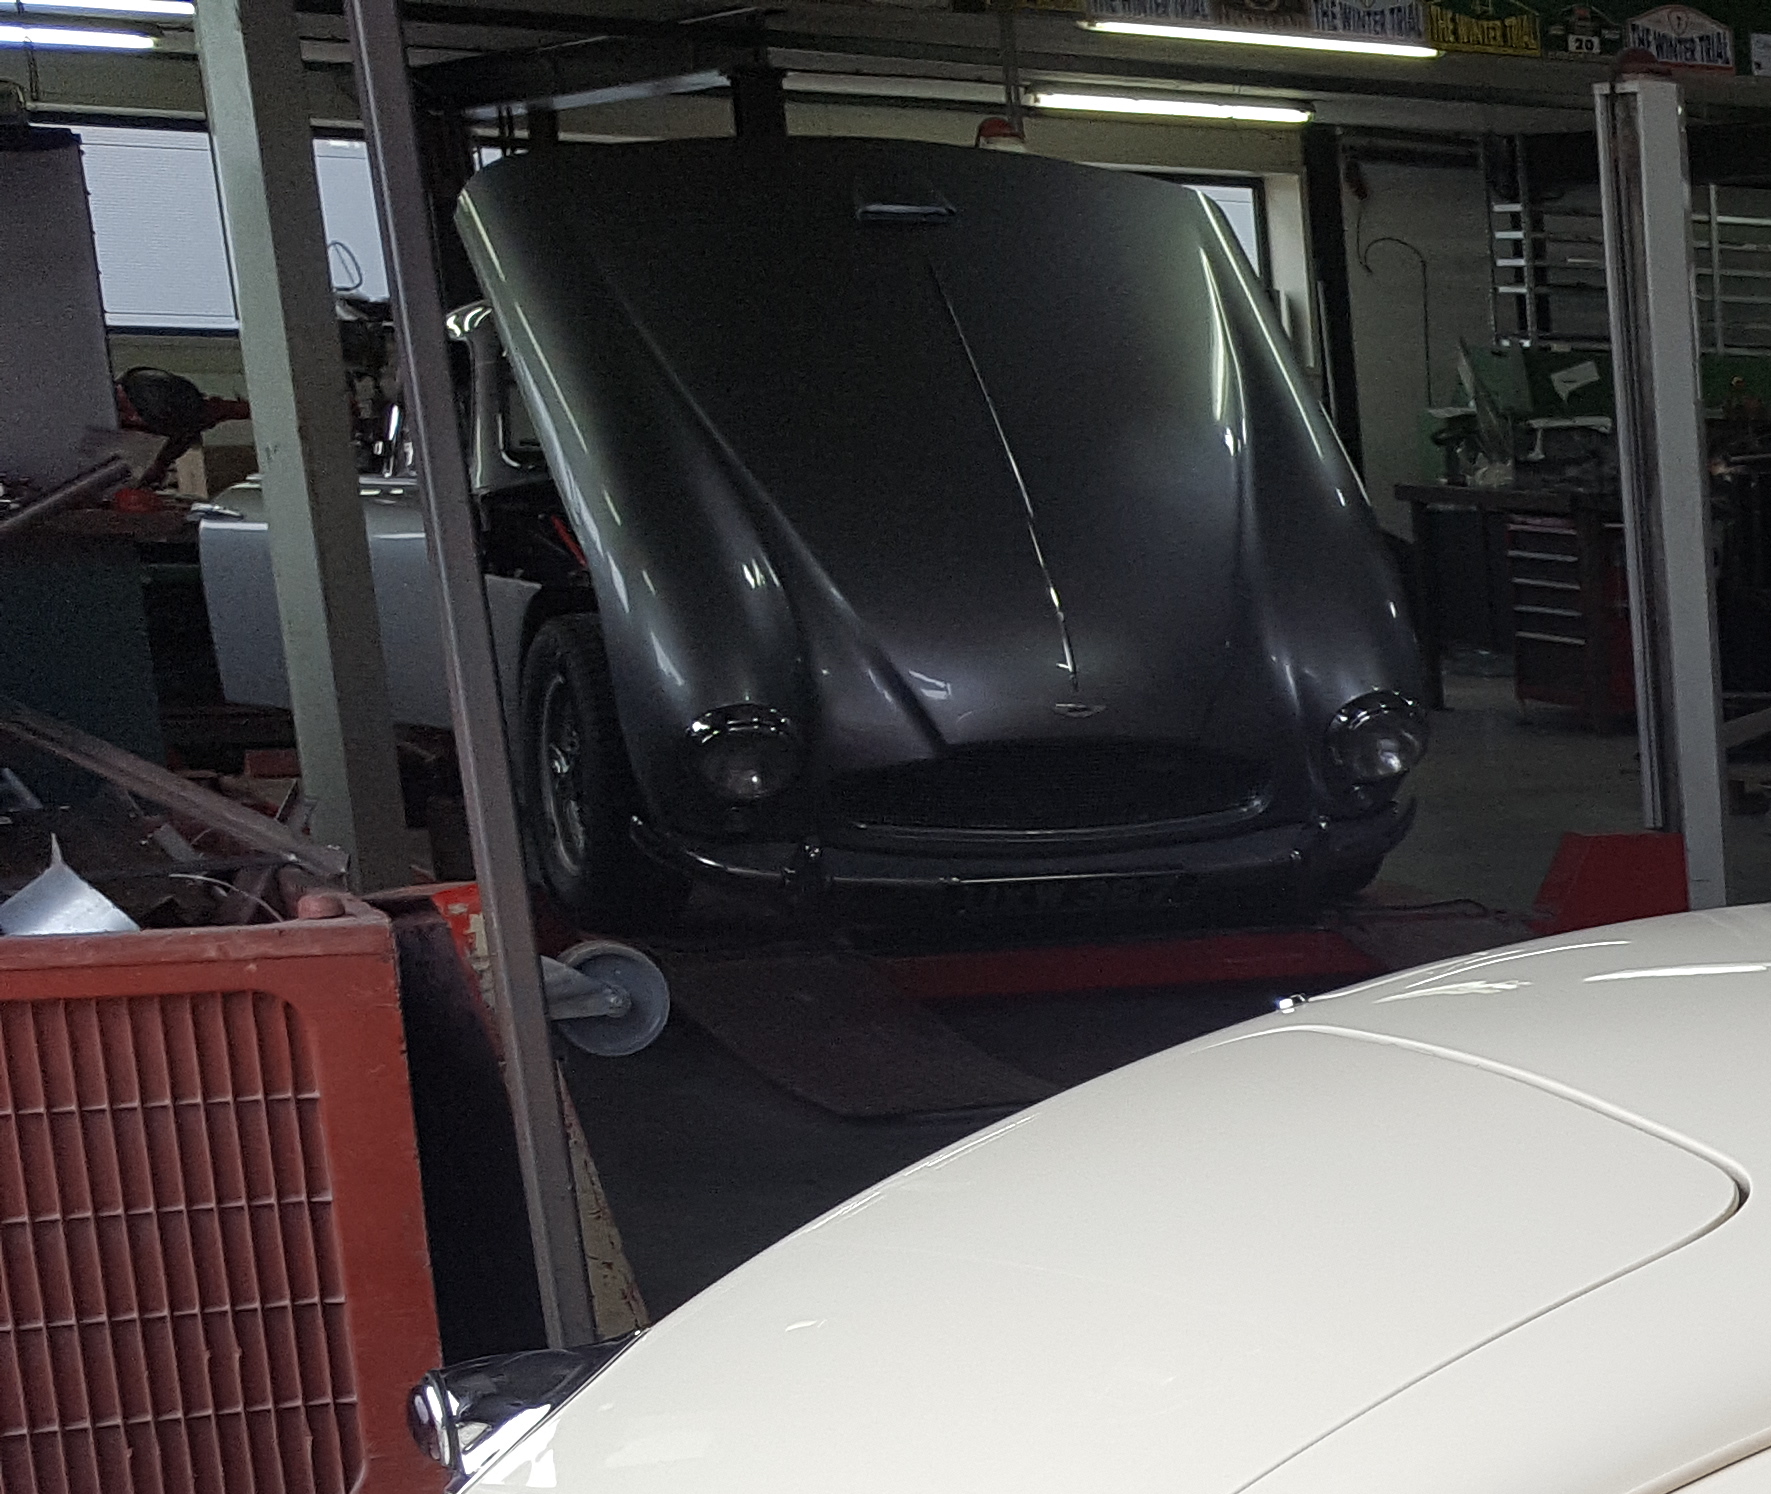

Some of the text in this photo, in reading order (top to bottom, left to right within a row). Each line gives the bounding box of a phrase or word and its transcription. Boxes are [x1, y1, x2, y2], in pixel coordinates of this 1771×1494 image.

[1314, 0, 1338, 31] THE
[1340, 1, 1384, 36] WINTER
[1389, 2, 1422, 40] TRIAL
[1429, 6, 1454, 43] THE
[1457, 14, 1503, 47] WINTER
[1655, 30, 1695, 61] WINTER
[1698, 31, 1729, 65] TRIAL
